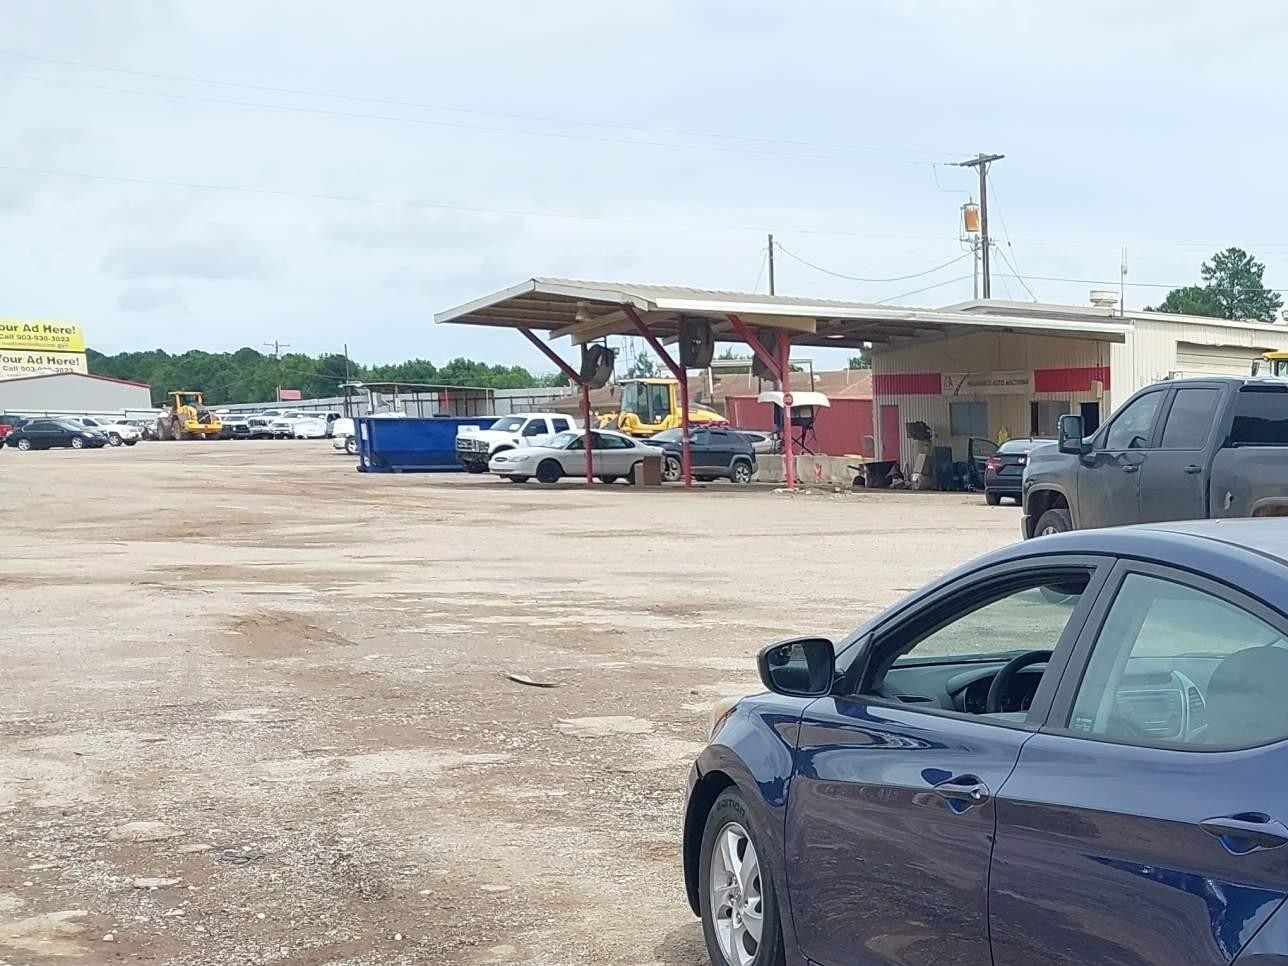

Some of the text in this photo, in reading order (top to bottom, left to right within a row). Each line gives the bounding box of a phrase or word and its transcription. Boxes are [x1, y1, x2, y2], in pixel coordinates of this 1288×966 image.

[23, 323, 39, 333] Ad
[43, 324, 76, 335] Here!
[27, 355, 43, 365] Ad
[47, 356, 79, 366] Here!
